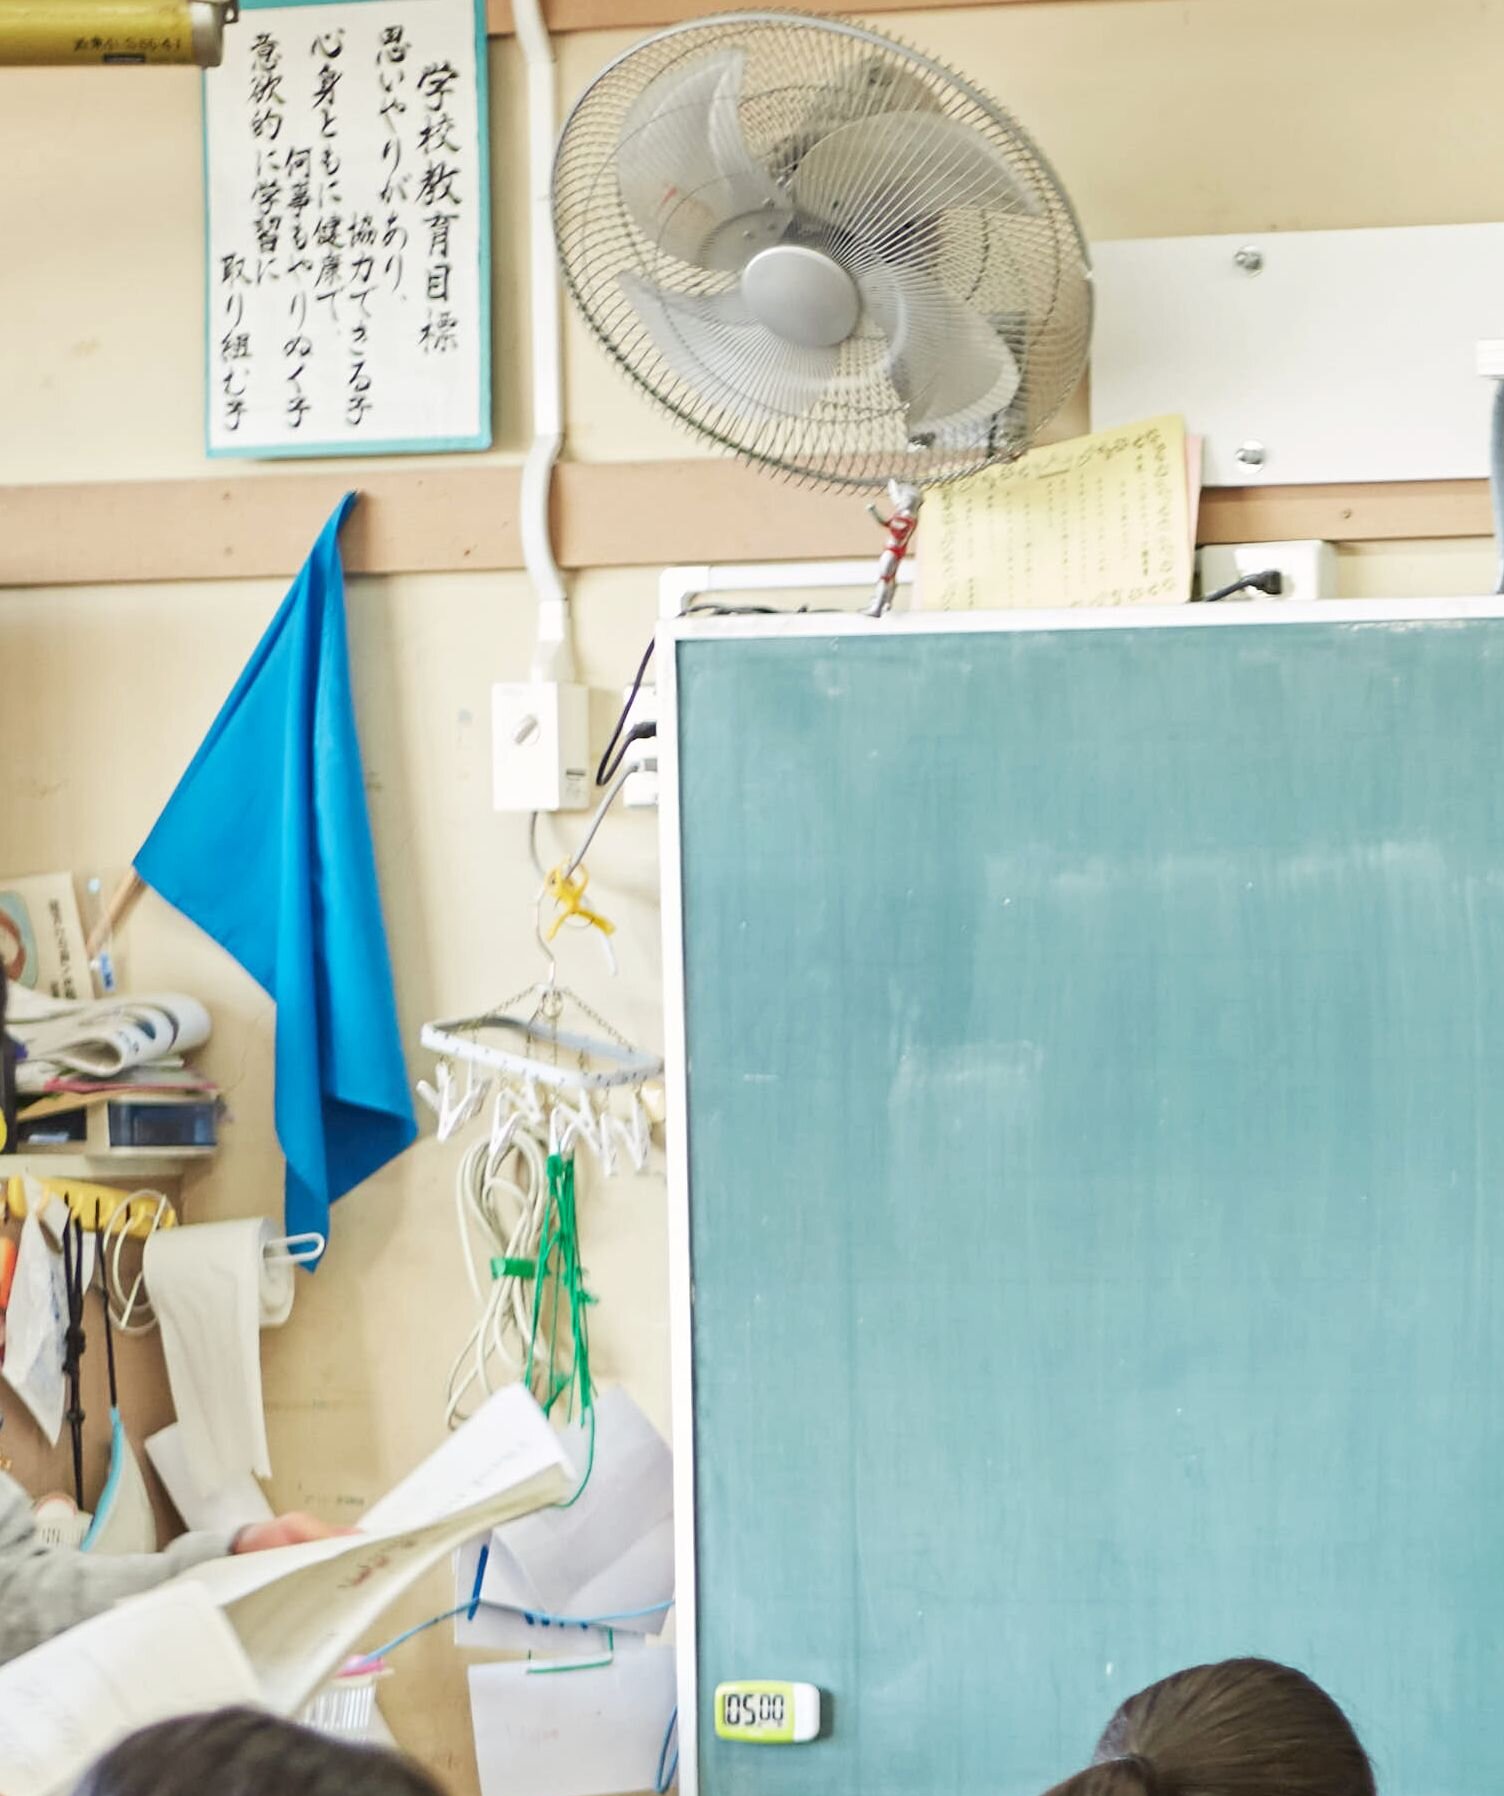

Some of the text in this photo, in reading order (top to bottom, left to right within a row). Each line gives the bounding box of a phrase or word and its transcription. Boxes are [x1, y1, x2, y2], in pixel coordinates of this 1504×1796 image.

[415, 60, 462, 355] 学校教育目標
[220, 252, 253, 431] 取り組む子
